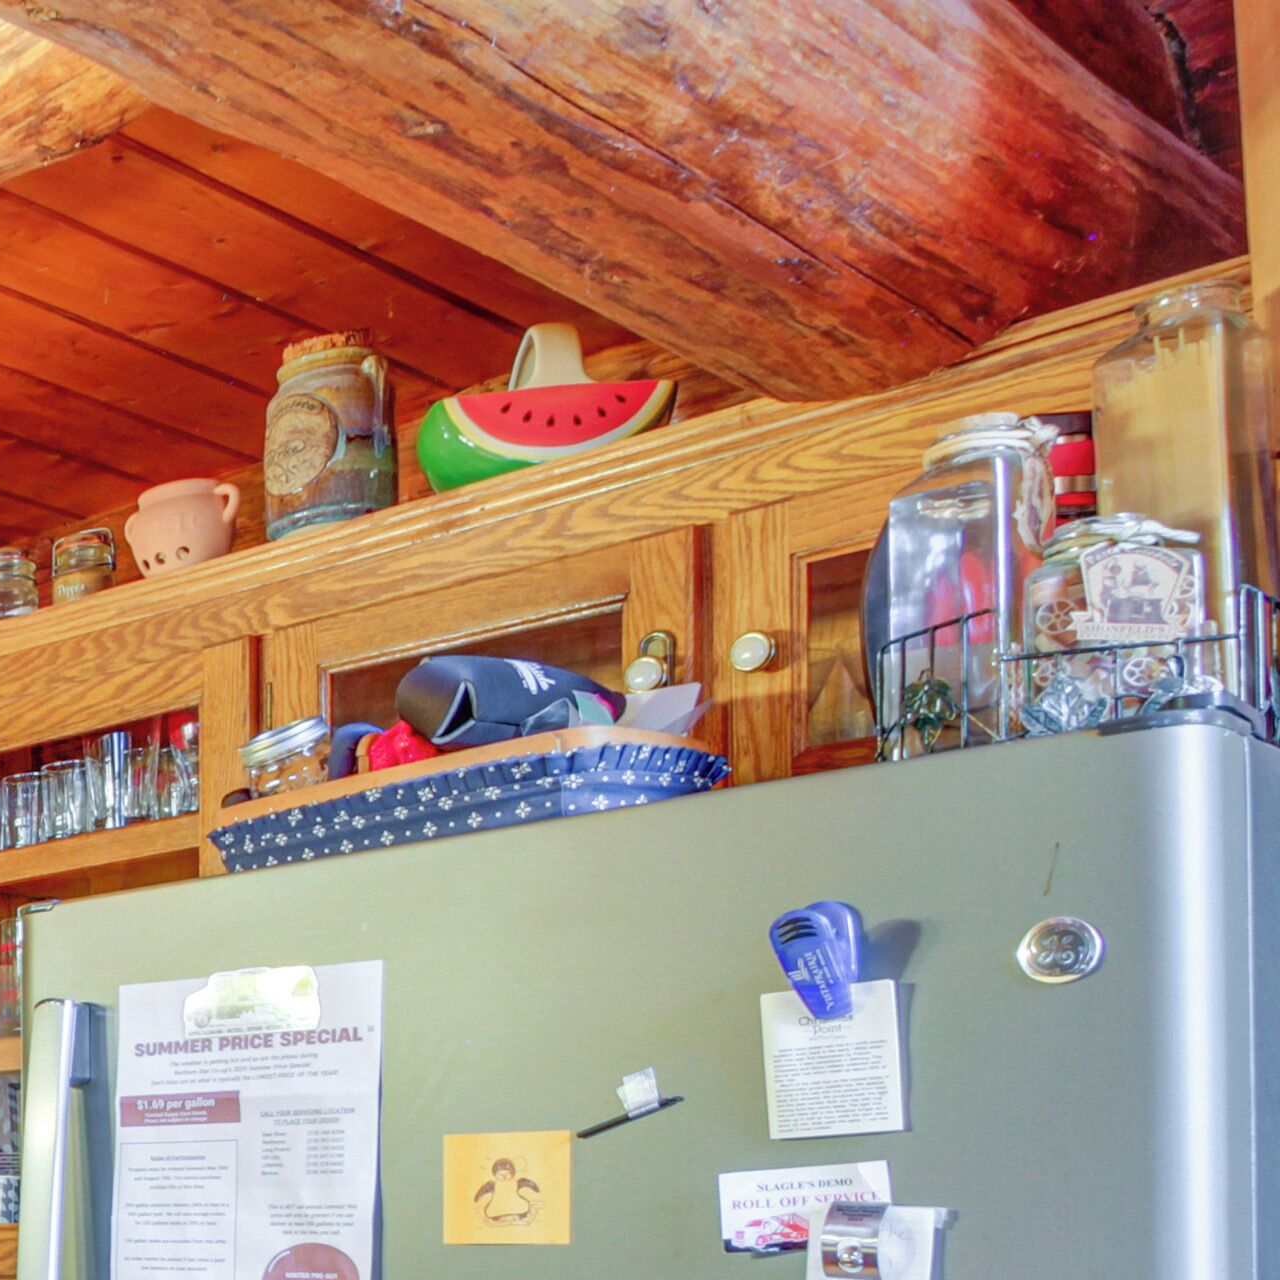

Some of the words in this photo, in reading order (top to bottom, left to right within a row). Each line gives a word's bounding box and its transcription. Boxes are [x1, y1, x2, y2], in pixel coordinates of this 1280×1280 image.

[134, 1038, 213, 1057] SUMMER
[219, 1034, 274, 1051] PRICE
[280, 1027, 363, 1047] SPECIAL
[137, 1099, 165, 1110] $1.69
[167, 1100, 182, 1110] per
[185, 1097, 216, 1110] gallon
[757, 1181, 816, 1192] SLAGLE'S
[818, 1178, 853, 1187] DEMO
[732, 1197, 775, 1210] ROLL
[779, 1196, 810, 1208] OFF
[814, 1190, 882, 1204] SERVICE
